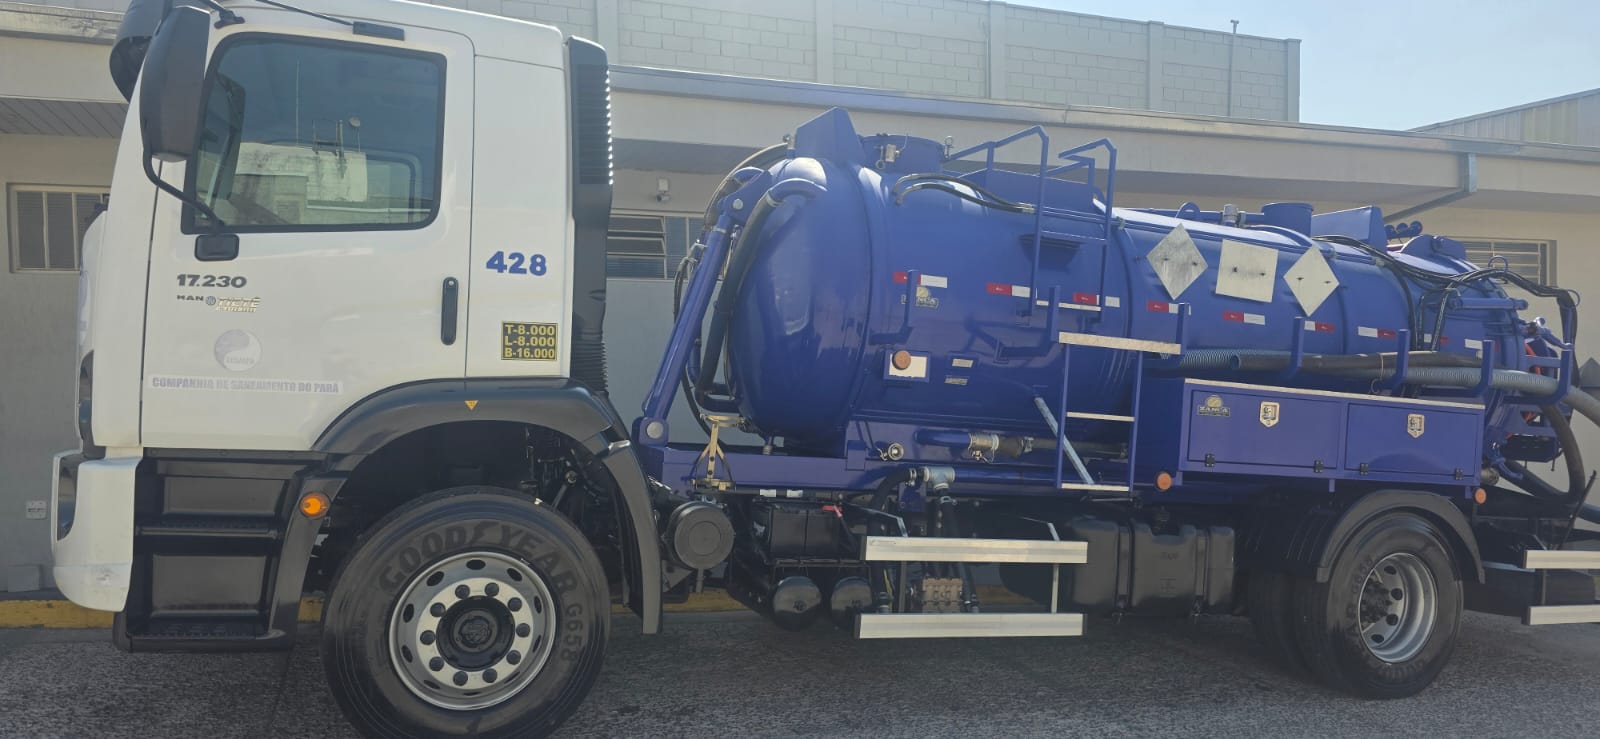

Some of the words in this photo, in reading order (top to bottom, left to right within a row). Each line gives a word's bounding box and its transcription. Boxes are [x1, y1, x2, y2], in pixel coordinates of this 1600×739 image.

[486, 250, 547, 277] 428
[176, 273, 247, 288] 17.230
[176, 294, 204, 302] MAN
[504, 324, 555, 336] T-8.000
[504, 335, 555, 347] L-8.000
[504, 347, 555, 359] B-16.000
[152, 377, 213, 390] COMPANHIA
[216, 378, 229, 390] DE
[230, 379, 296, 392] SANEAMENTO
[298, 381, 312, 393] DO
